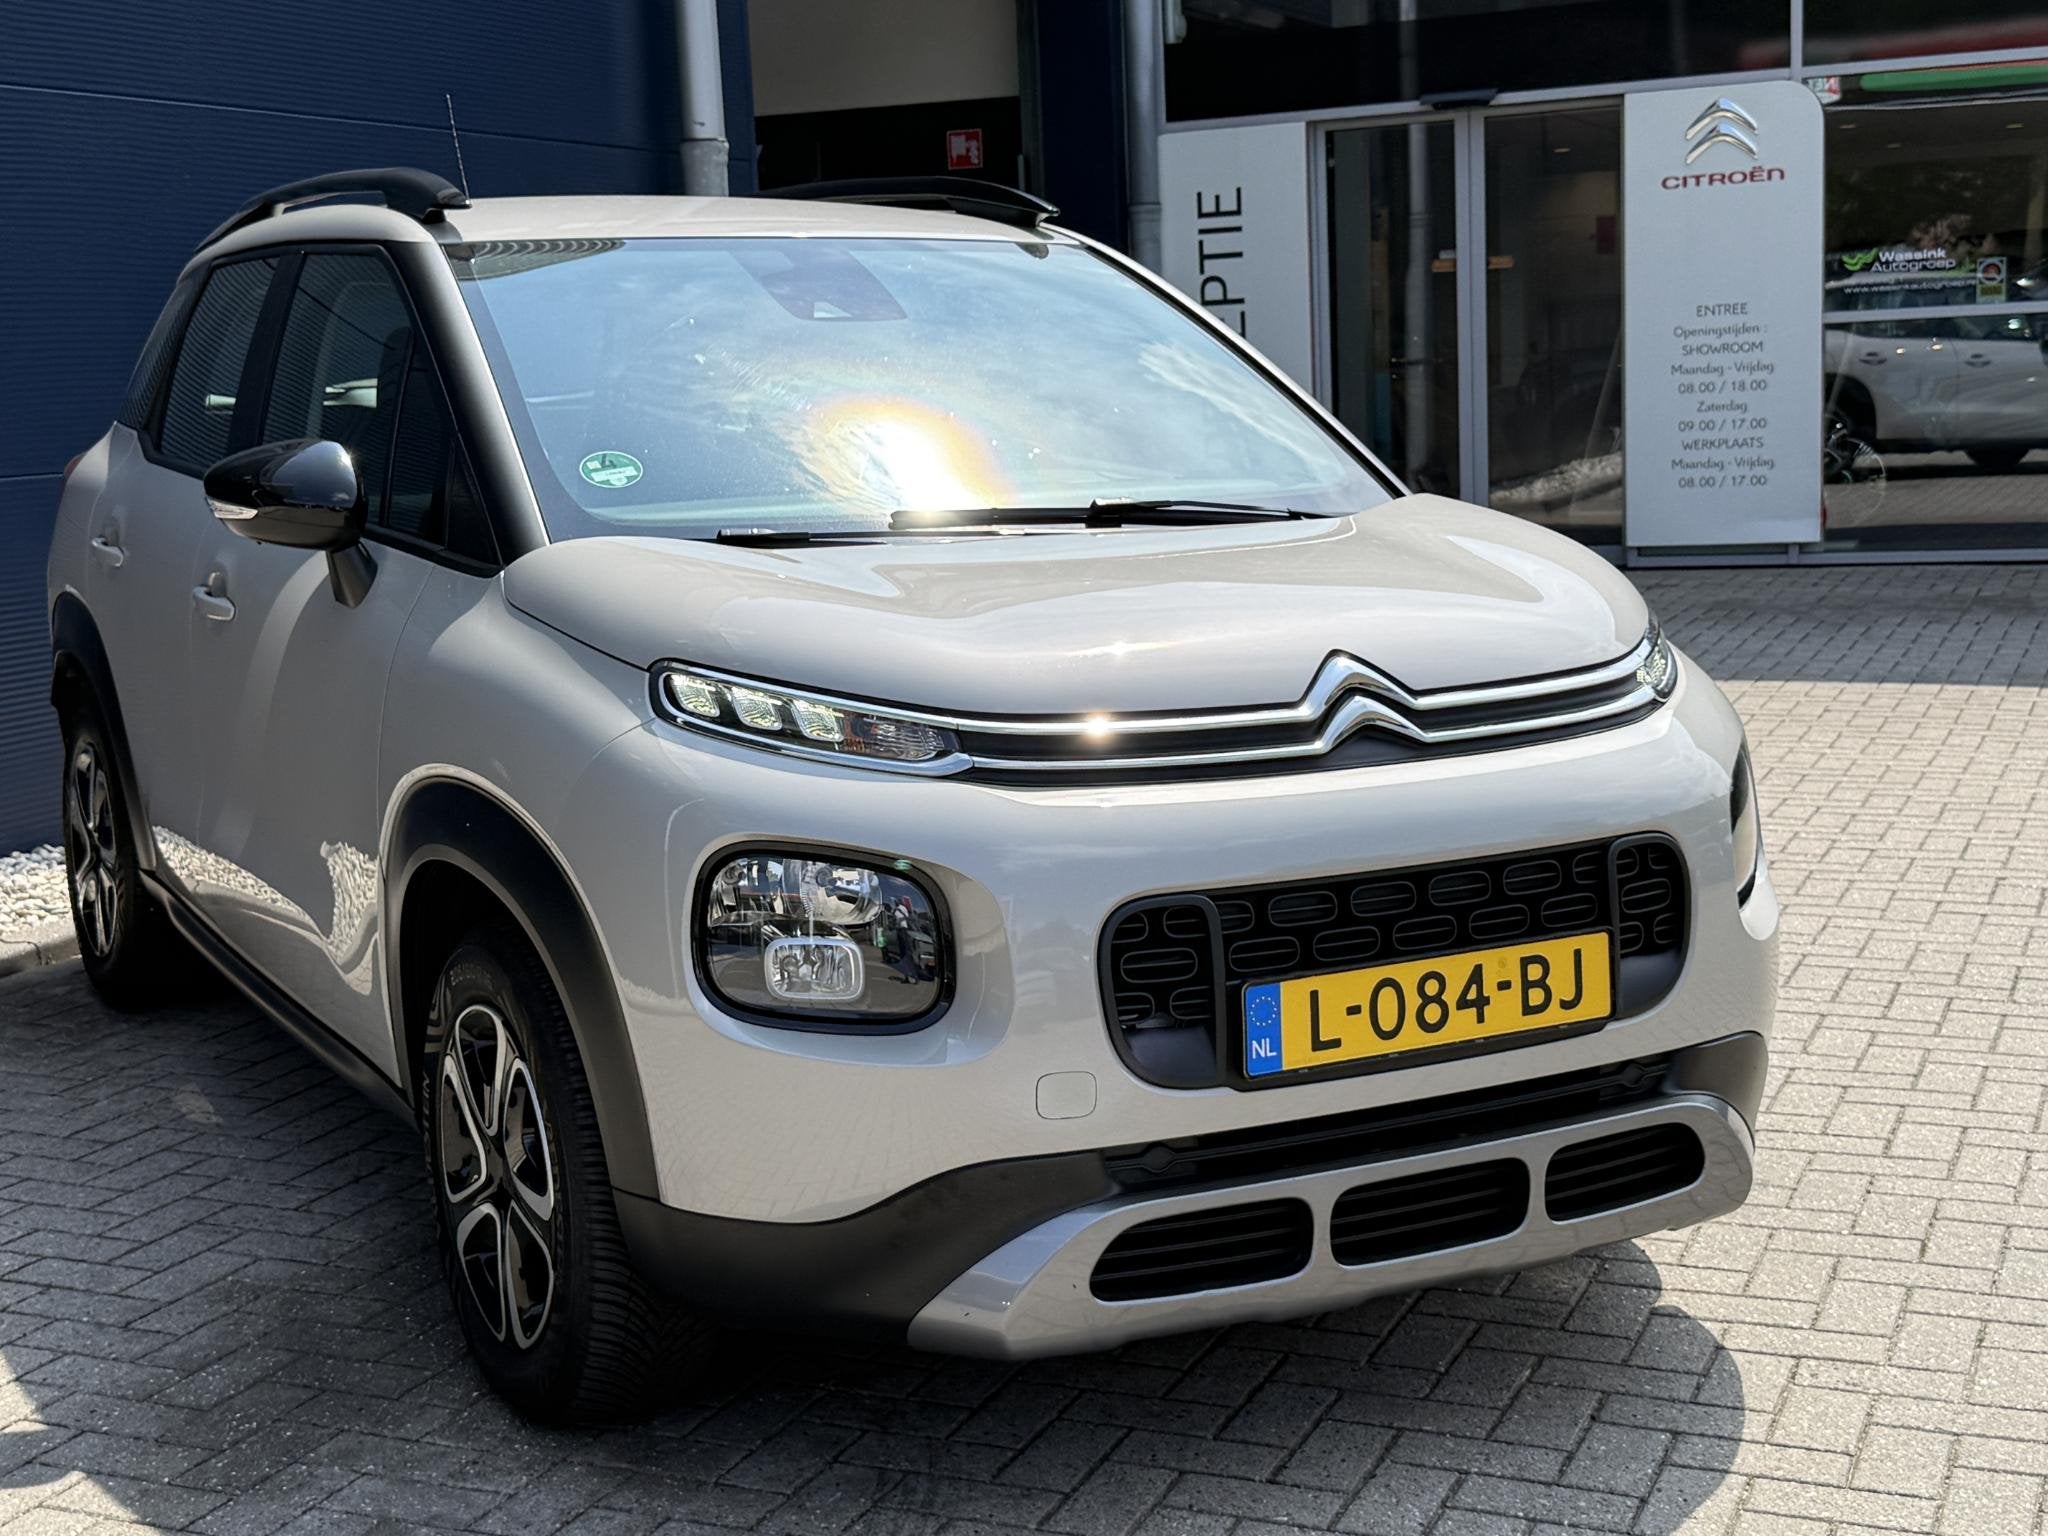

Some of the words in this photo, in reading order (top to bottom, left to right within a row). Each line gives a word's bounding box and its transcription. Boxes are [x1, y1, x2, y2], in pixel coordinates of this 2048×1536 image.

[1879, 248, 1946, 262] Wassink
[1870, 259, 1957, 273] Autogroep
[1696, 302, 1748, 317] ENTREE
[1682, 341, 1763, 356] SHOWROOM
[1671, 362, 1724, 377] Maandag
[1734, 360, 1774, 375] Vrijdag
[1696, 400, 1748, 414] Zaterdag
[1682, 436, 1764, 451] WERKPLAATS
[1671, 458, 1724, 472] Maandag
[1734, 456, 1775, 471] Vrijdag
[1310, 948, 1583, 1053] L-084-BJ
[1251, 1038, 1277, 1059] NL
